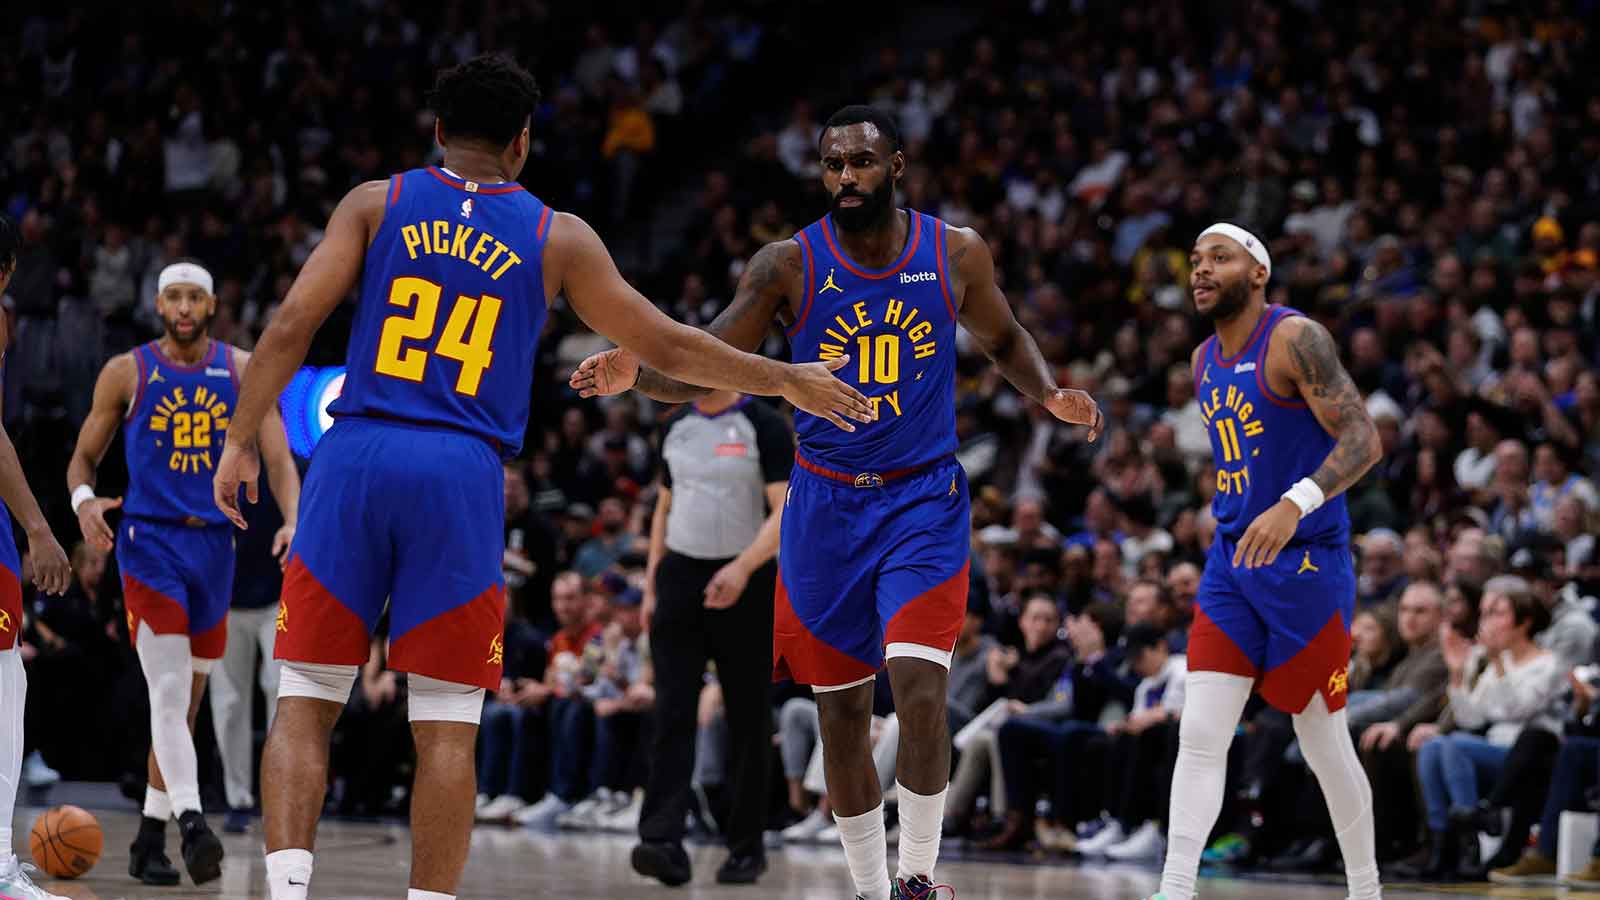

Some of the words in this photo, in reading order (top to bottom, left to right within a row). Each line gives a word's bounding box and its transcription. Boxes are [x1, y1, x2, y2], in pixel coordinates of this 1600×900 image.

[401, 220, 522, 280] PICKETT
[900, 271, 937, 284] ibotta
[374, 275, 502, 397] 24
[819, 301, 873, 361] MILE
[884, 298, 936, 360] HIGH
[856, 333, 900, 384] 10
[149, 386, 188, 431] MILE
[194, 384, 229, 431] HIGH
[868, 391, 902, 421] TY
[1225, 384, 1265, 437] HIGH
[172, 411, 211, 448] 22
[1215, 417, 1242, 462] 11
[169, 450, 213, 474] CITY
[1217, 465, 1250, 495] CITY
